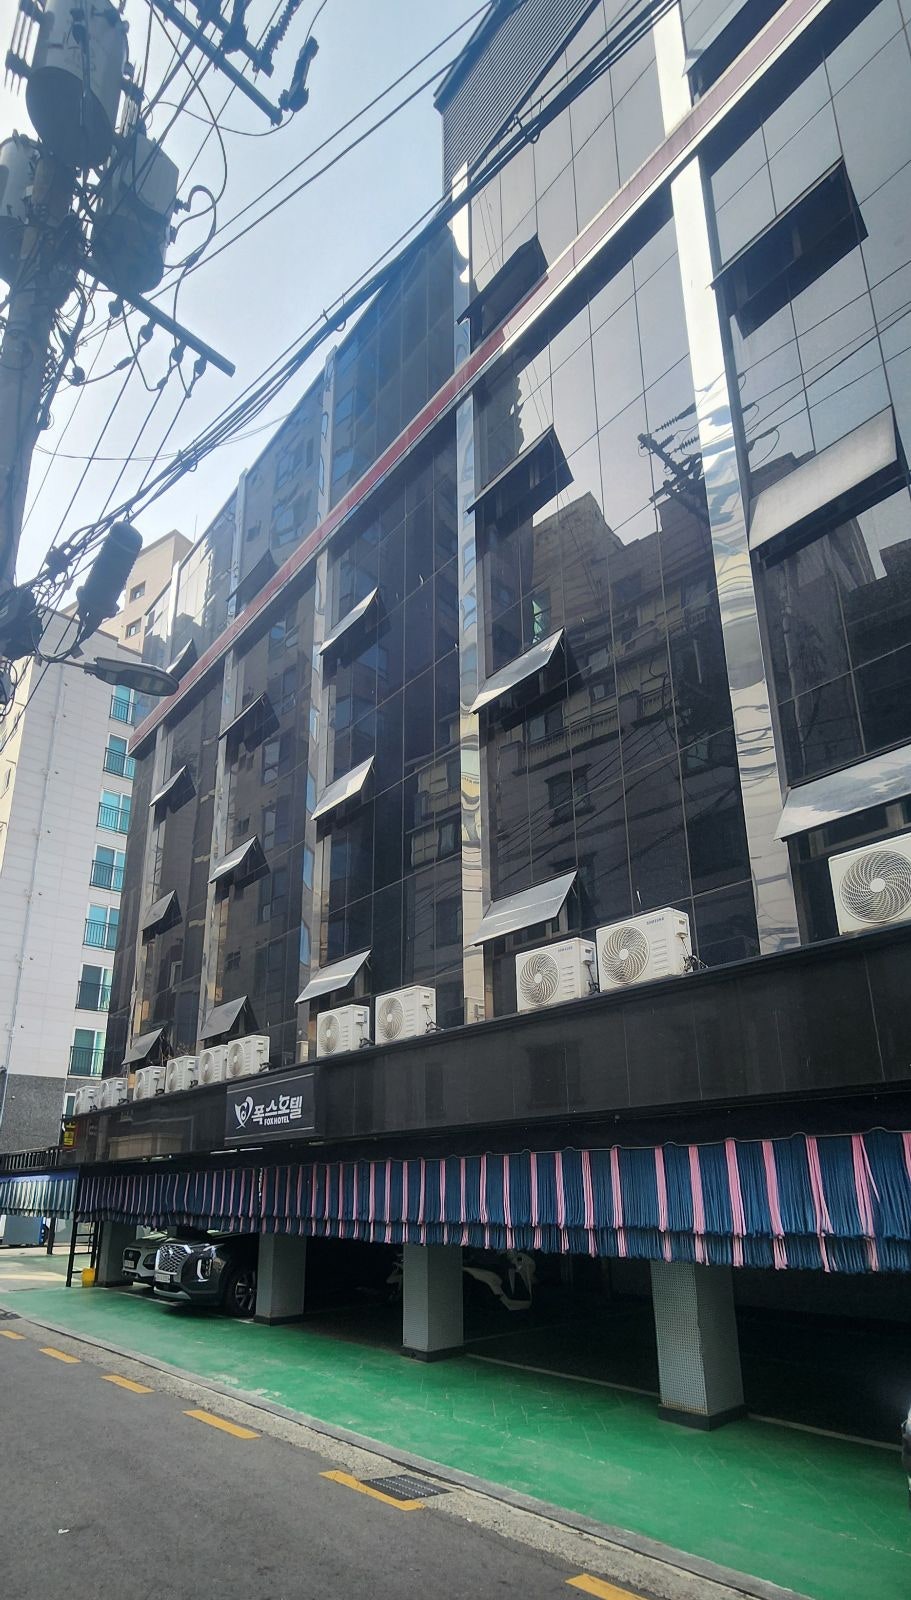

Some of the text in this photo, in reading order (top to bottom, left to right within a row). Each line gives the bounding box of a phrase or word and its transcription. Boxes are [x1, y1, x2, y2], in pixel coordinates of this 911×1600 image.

[251, 1094, 303, 1125] 폭스호텔
[264, 1116, 290, 1126] FOX HOTEL
